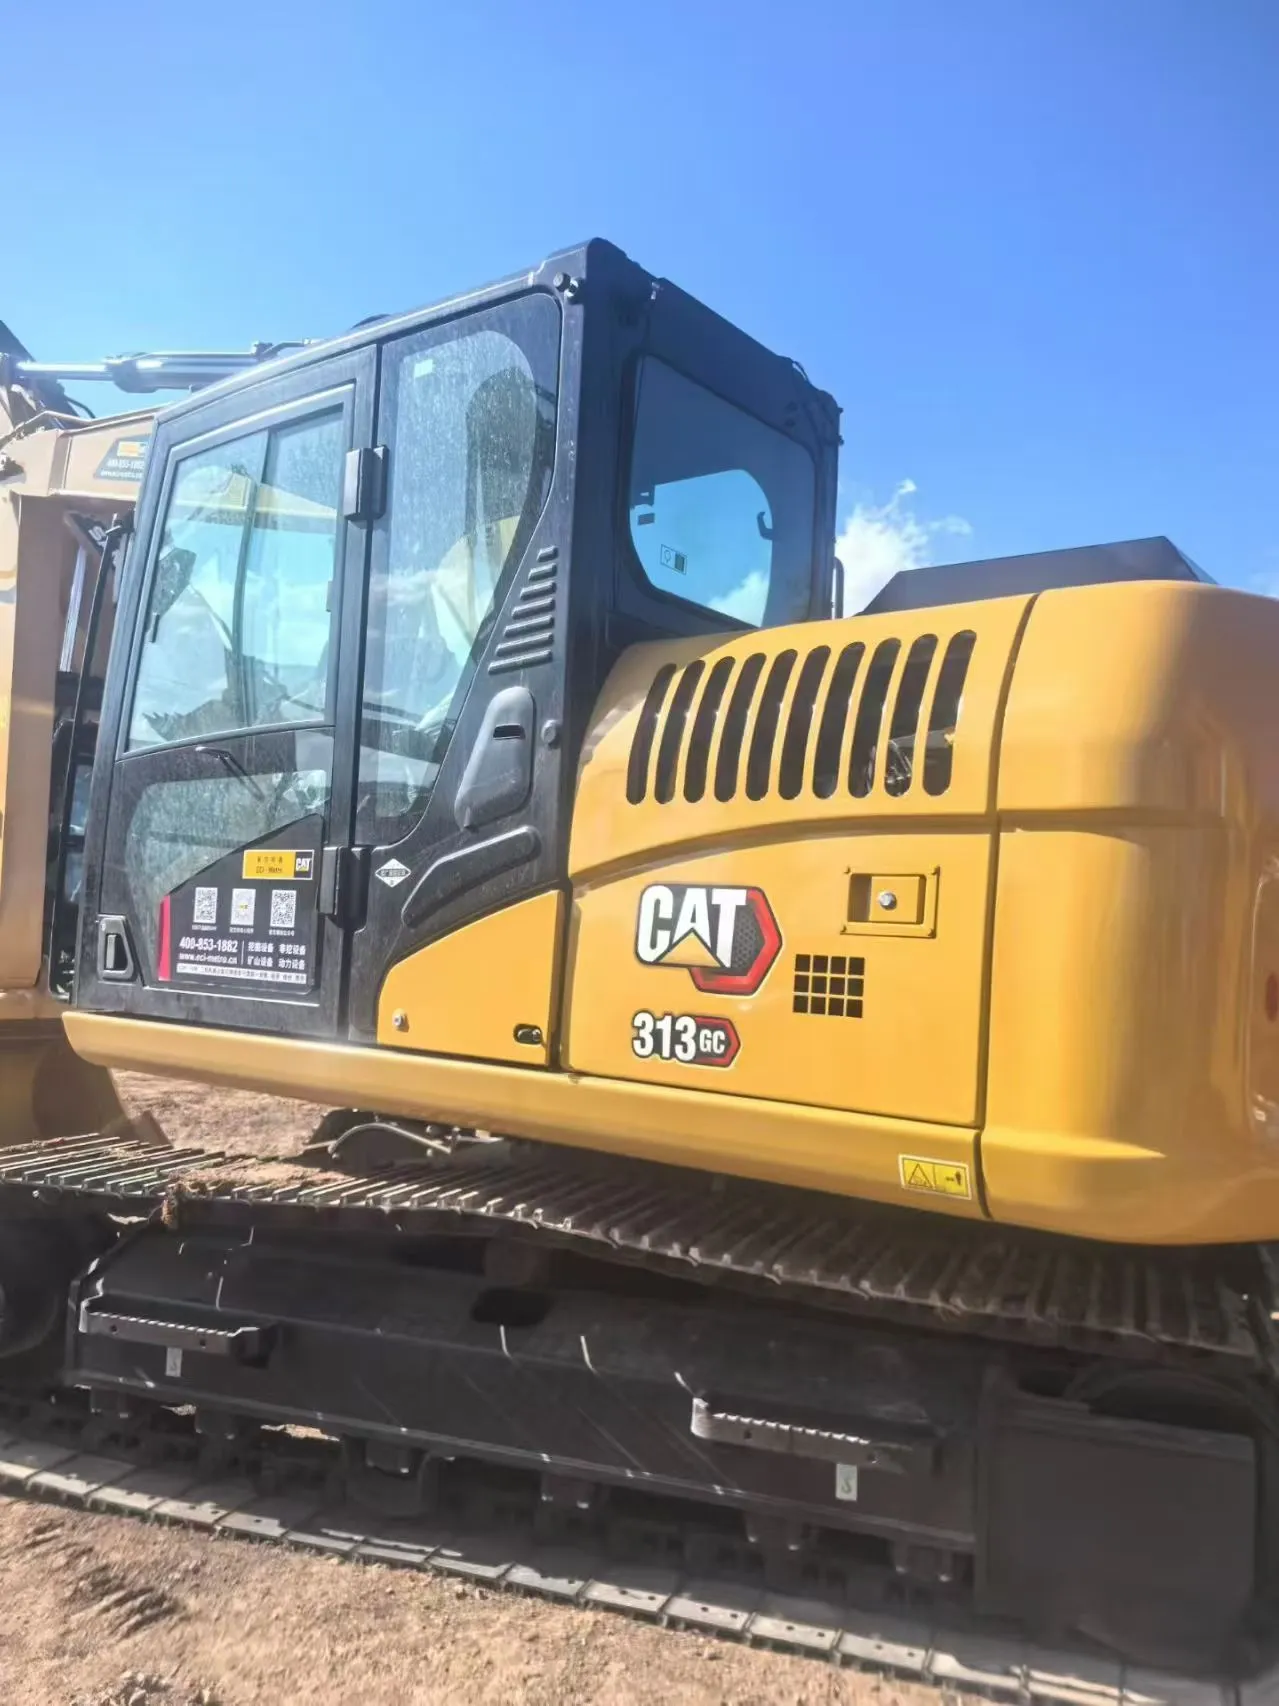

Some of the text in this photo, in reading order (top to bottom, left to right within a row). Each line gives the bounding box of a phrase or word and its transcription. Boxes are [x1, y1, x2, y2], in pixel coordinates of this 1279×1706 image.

[295, 858, 311, 871] CAT
[637, 885, 747, 968] CAT
[633, 1012, 726, 1062] 313 GC
